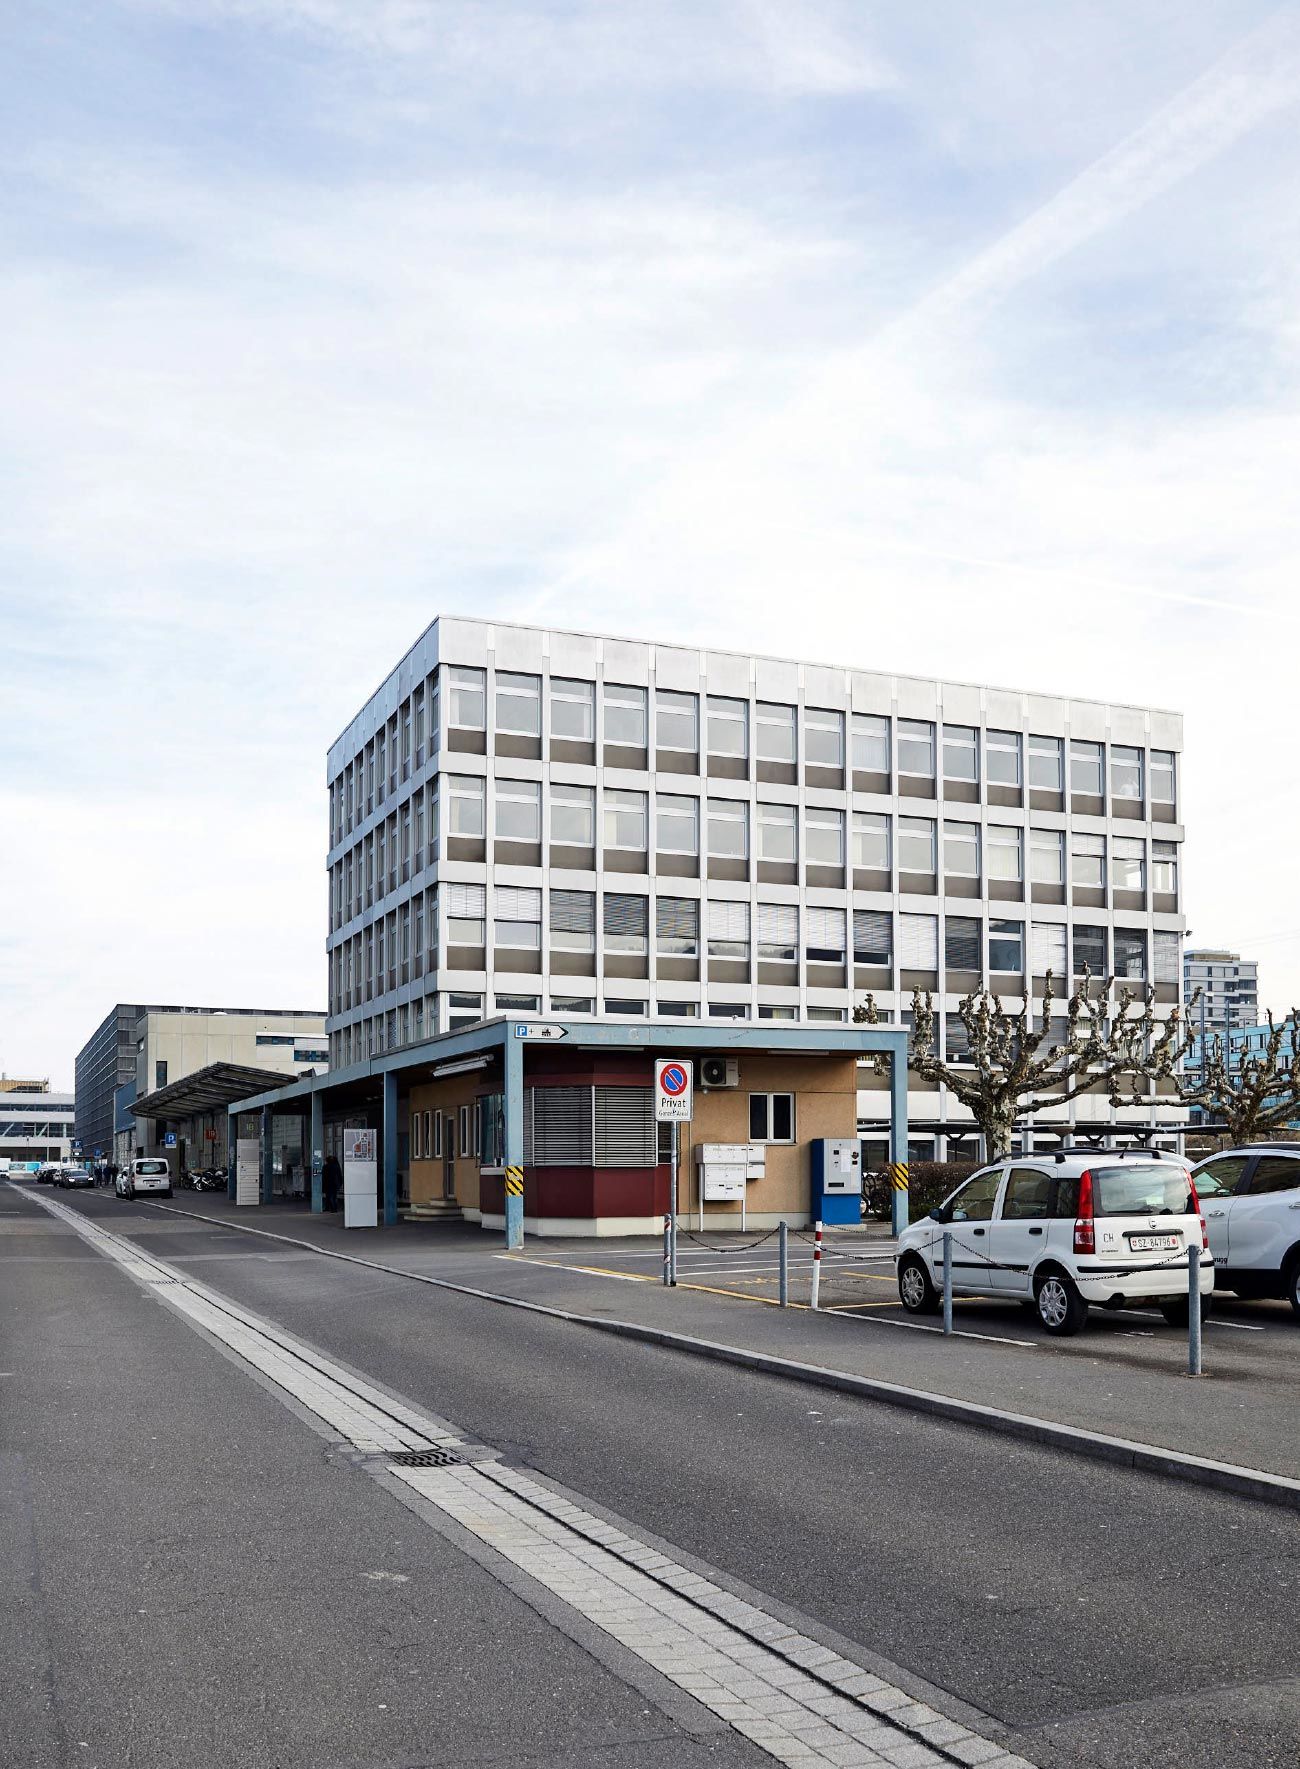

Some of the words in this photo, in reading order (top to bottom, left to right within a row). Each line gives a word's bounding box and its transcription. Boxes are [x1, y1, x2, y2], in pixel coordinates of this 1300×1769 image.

[519, 1027, 526, 1036] P
[661, 1097, 687, 1108] Privat
[1103, 1233, 1114, 1243] CH
